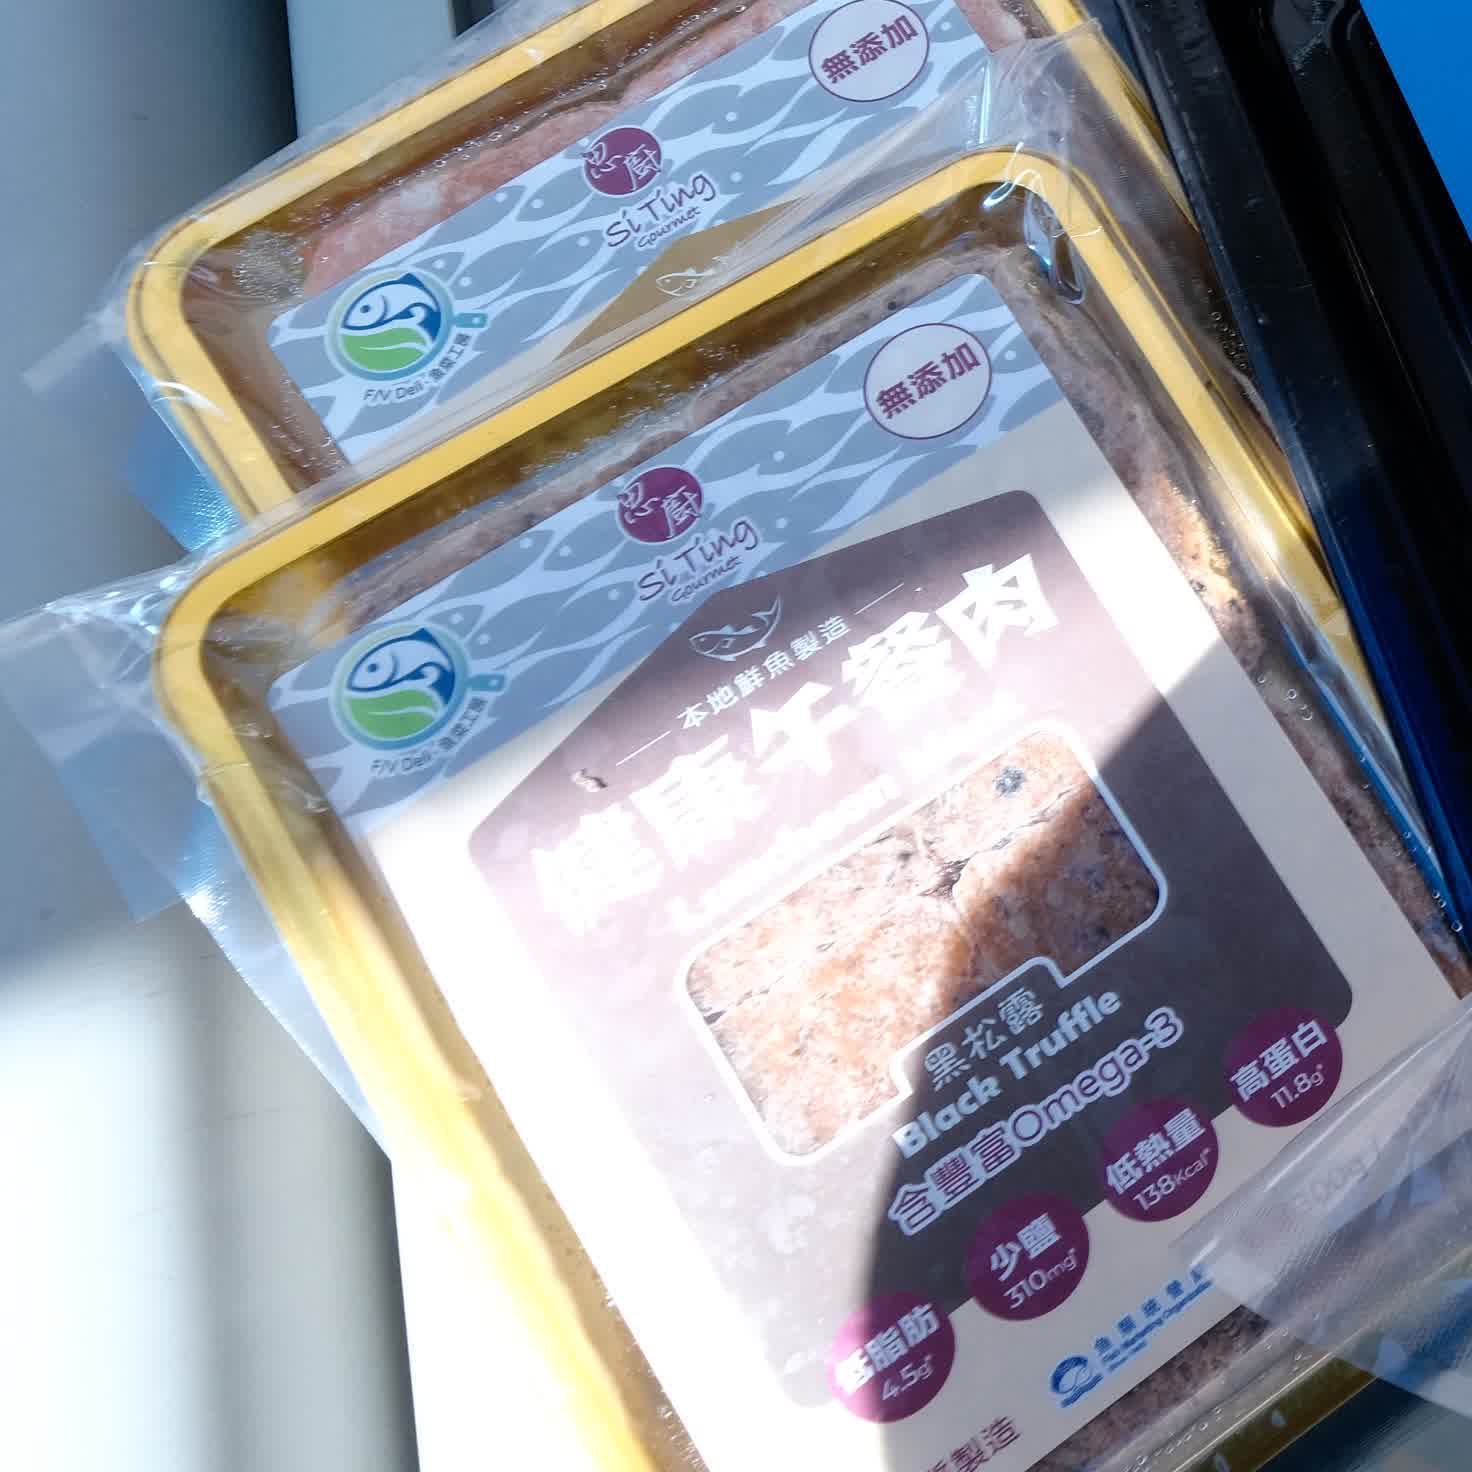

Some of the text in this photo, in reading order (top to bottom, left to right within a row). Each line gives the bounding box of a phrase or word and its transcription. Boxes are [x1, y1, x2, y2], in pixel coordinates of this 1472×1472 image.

[821, 15, 918, 84] 無添加
[638, 174, 716, 224] Ting
[638, 205, 702, 248] Gourmet
[876, 341, 981, 419] 無添加
[671, 555, 739, 602] Gourmet
[672, 518, 761, 578] Ting
[680, 614, 851, 729] 本地鮮魚製造
[892, 990, 1122, 1160] Black Truffle
[925, 988, 1044, 1091] 黑松露
[1230, 1019, 1328, 1102] 高蛋白
[1105, 1107, 1205, 1196] 低熱量
[988, 1212, 1062, 1283] 少鹽
